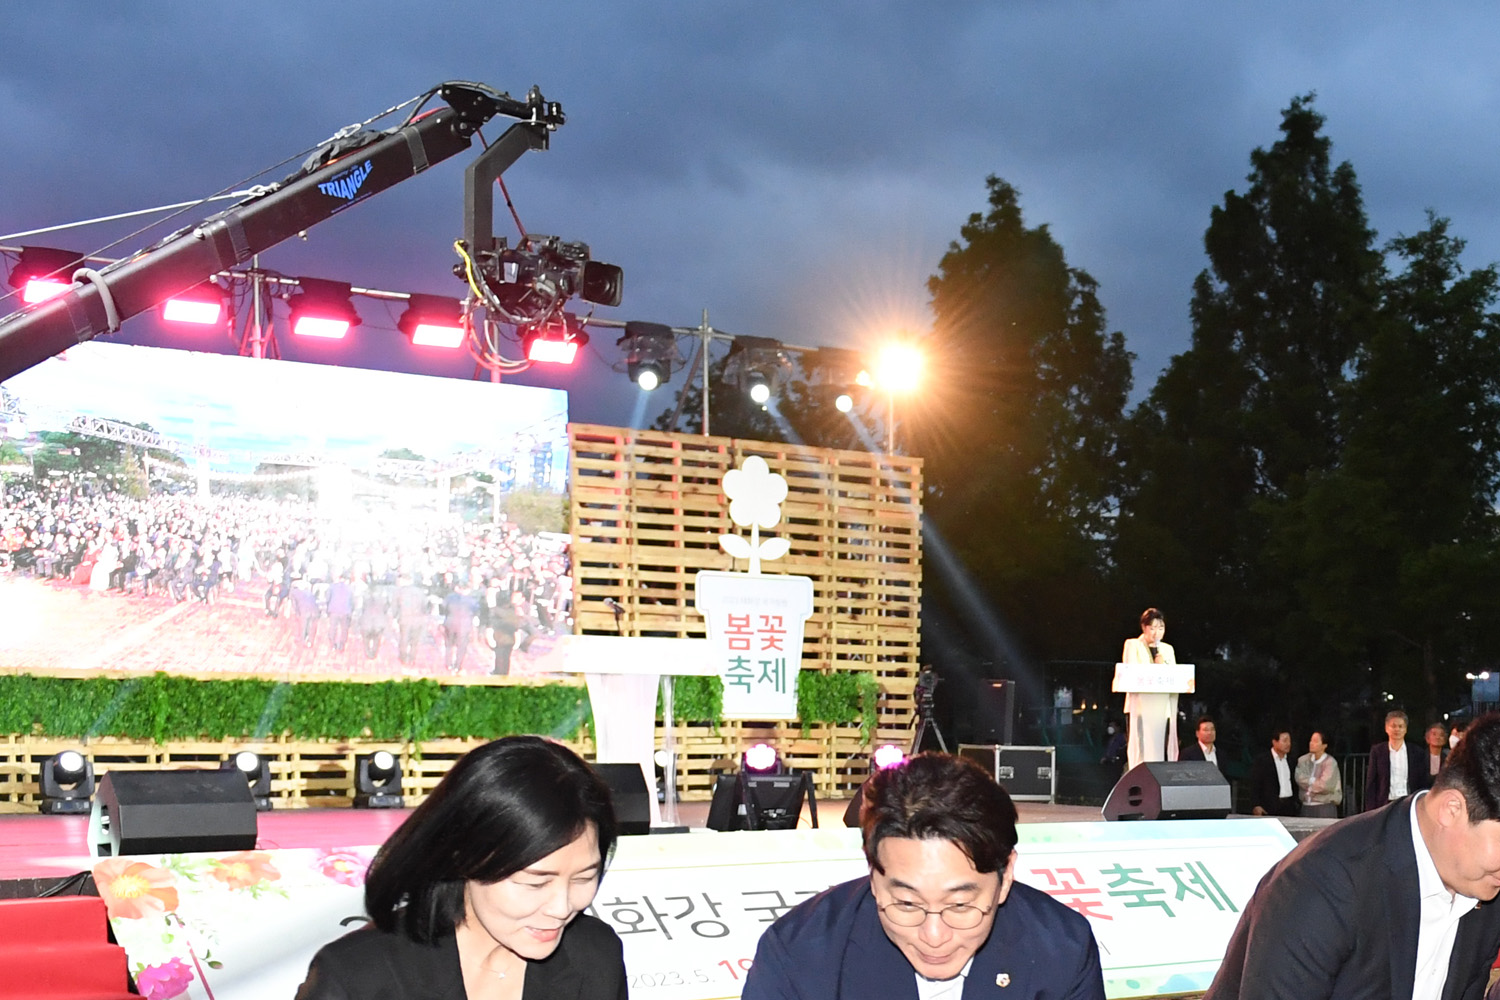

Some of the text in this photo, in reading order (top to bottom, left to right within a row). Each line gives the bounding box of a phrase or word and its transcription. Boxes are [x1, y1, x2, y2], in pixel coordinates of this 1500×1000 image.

[318, 160, 373, 200] TRIANGLE
[724, 613, 787, 651] 봄꽃
[724, 655, 786, 694] 축제
[590, 892, 731, 941] 화강
